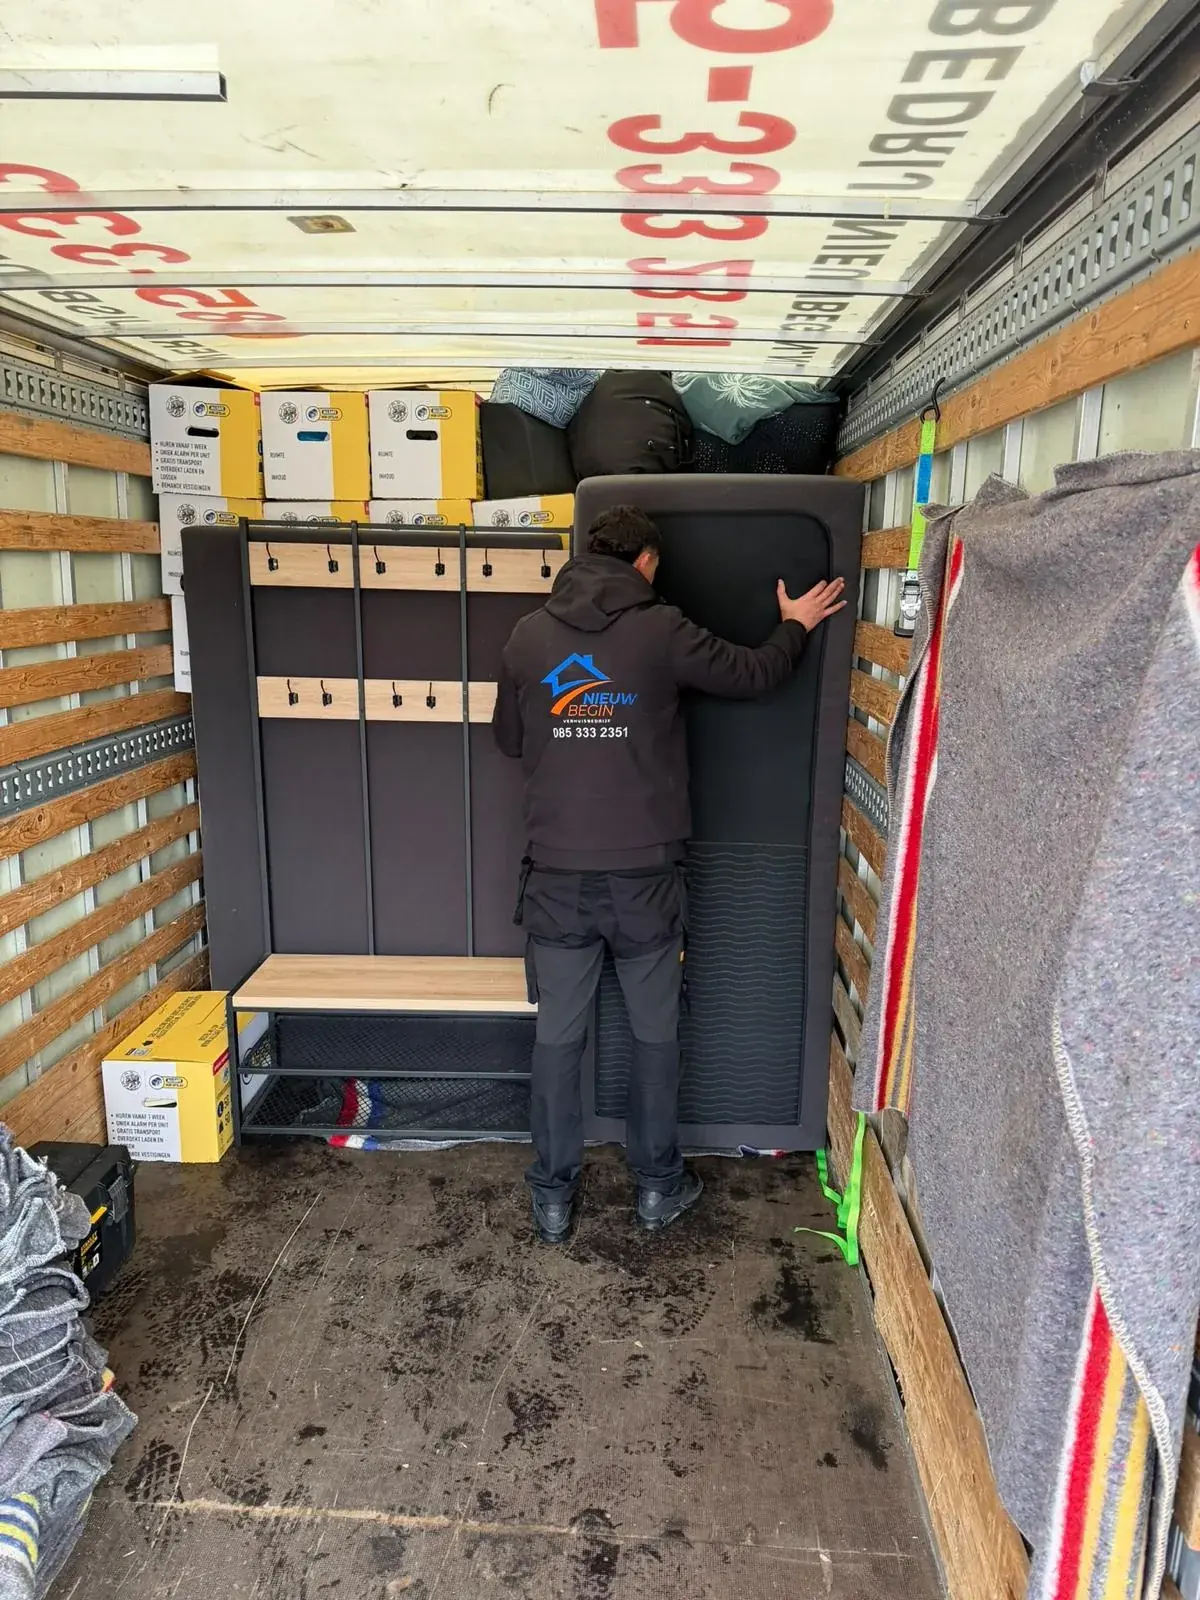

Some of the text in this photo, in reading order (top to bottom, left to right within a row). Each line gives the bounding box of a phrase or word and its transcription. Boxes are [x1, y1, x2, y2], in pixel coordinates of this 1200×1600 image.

[583, 693, 638, 705] NIEUW
[568, 704, 614, 717] BEGIN
[553, 726, 628, 738] 085 333 2351
